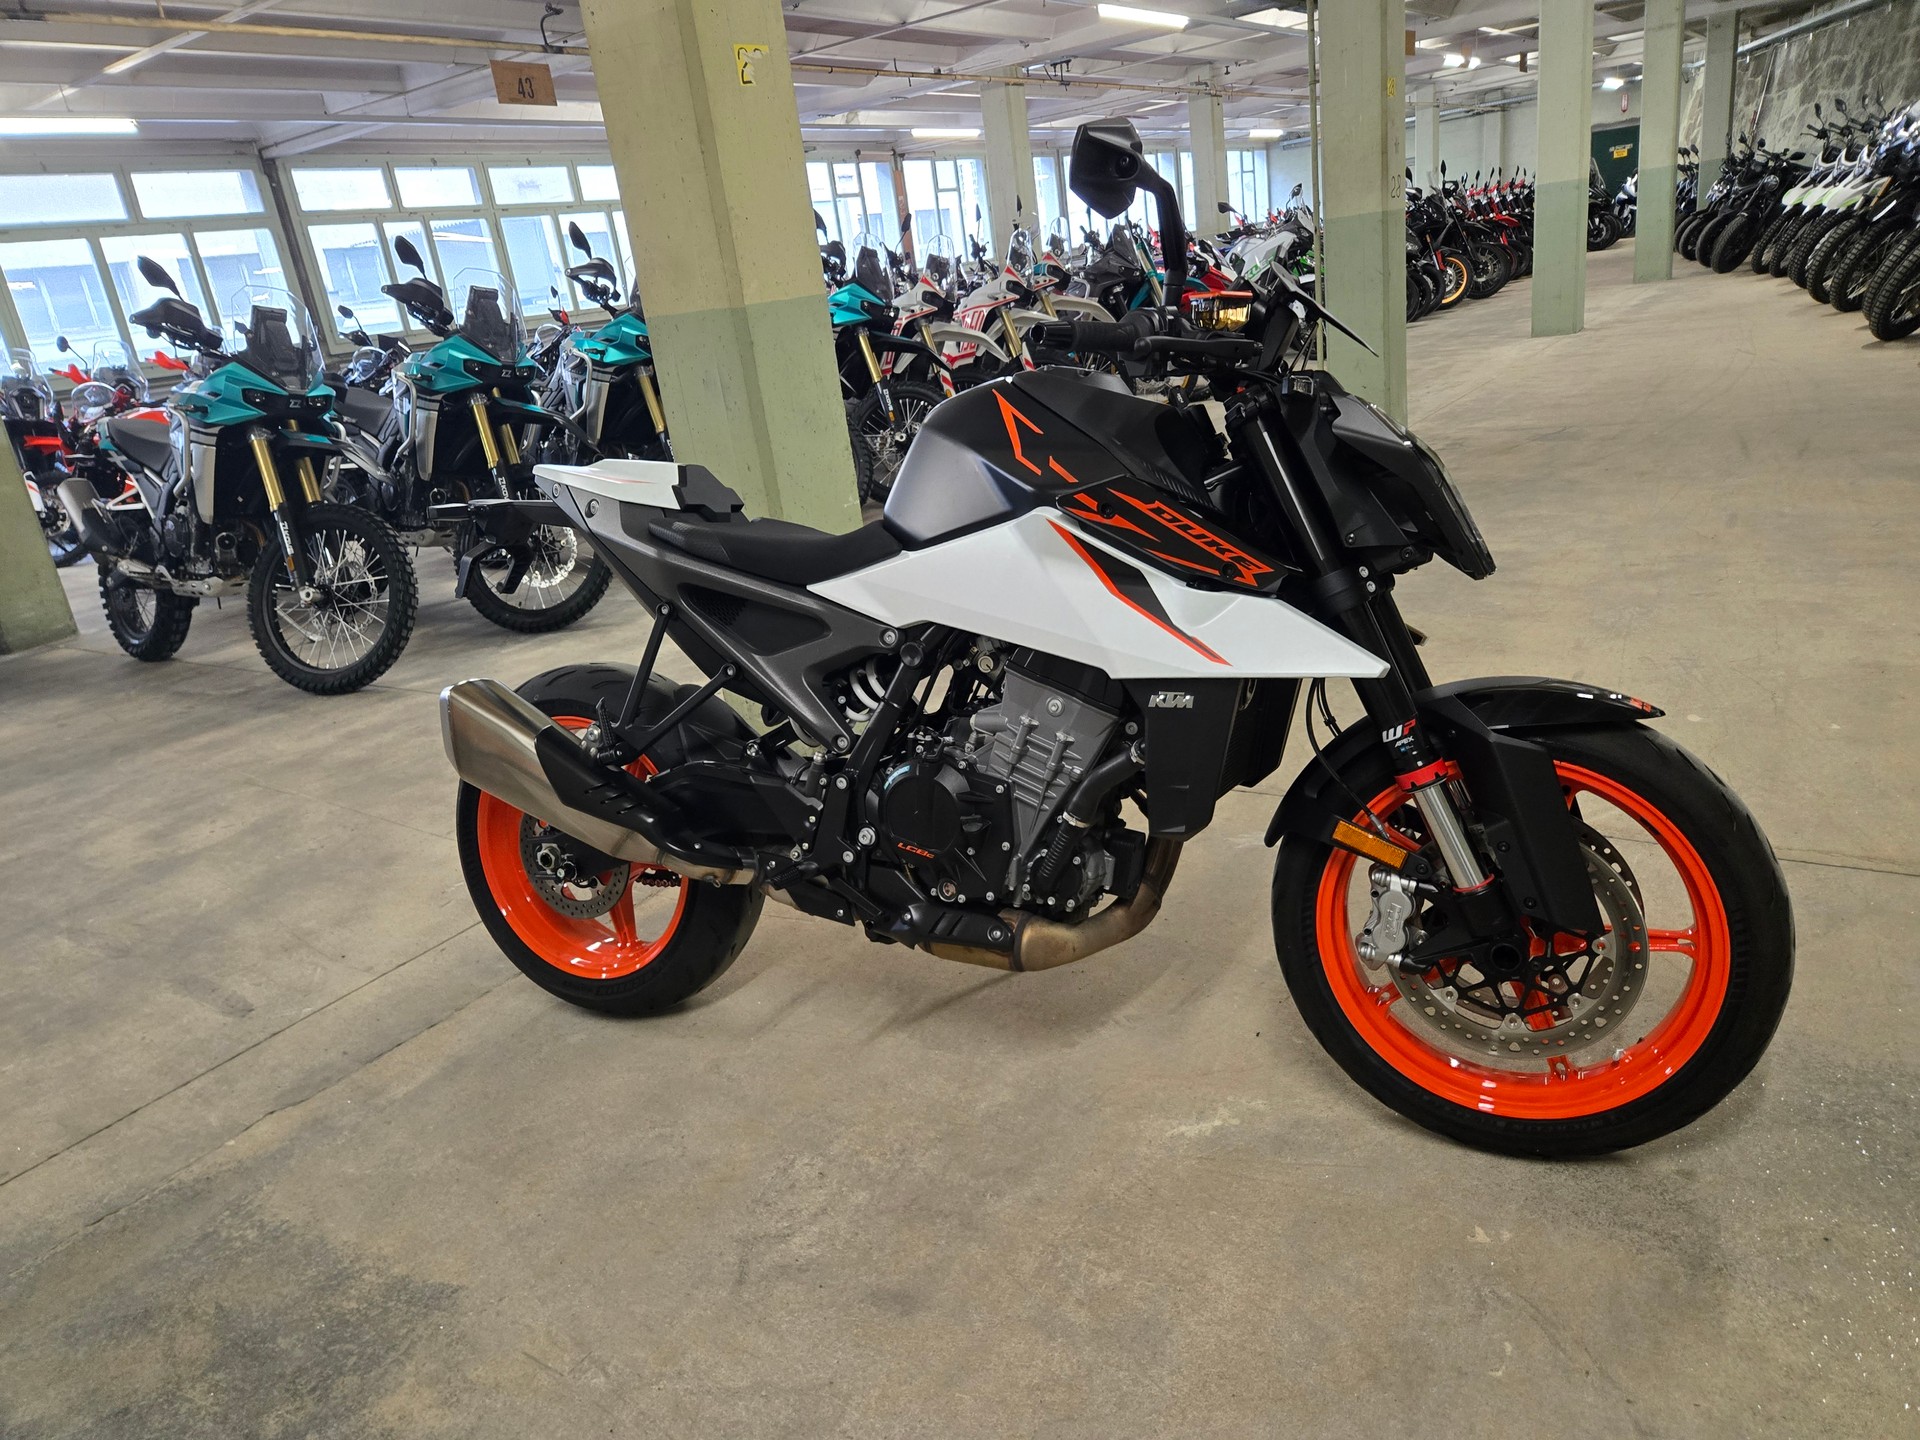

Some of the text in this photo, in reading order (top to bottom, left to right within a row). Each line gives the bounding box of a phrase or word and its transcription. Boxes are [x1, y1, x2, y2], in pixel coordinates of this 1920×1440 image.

[517, 77, 535, 99] 43
[1146, 504, 1266, 574] DUKE
[1147, 690, 1195, 709] KTM
[1382, 719, 1416, 743] WP
[1394, 735, 1415, 748] APEX
